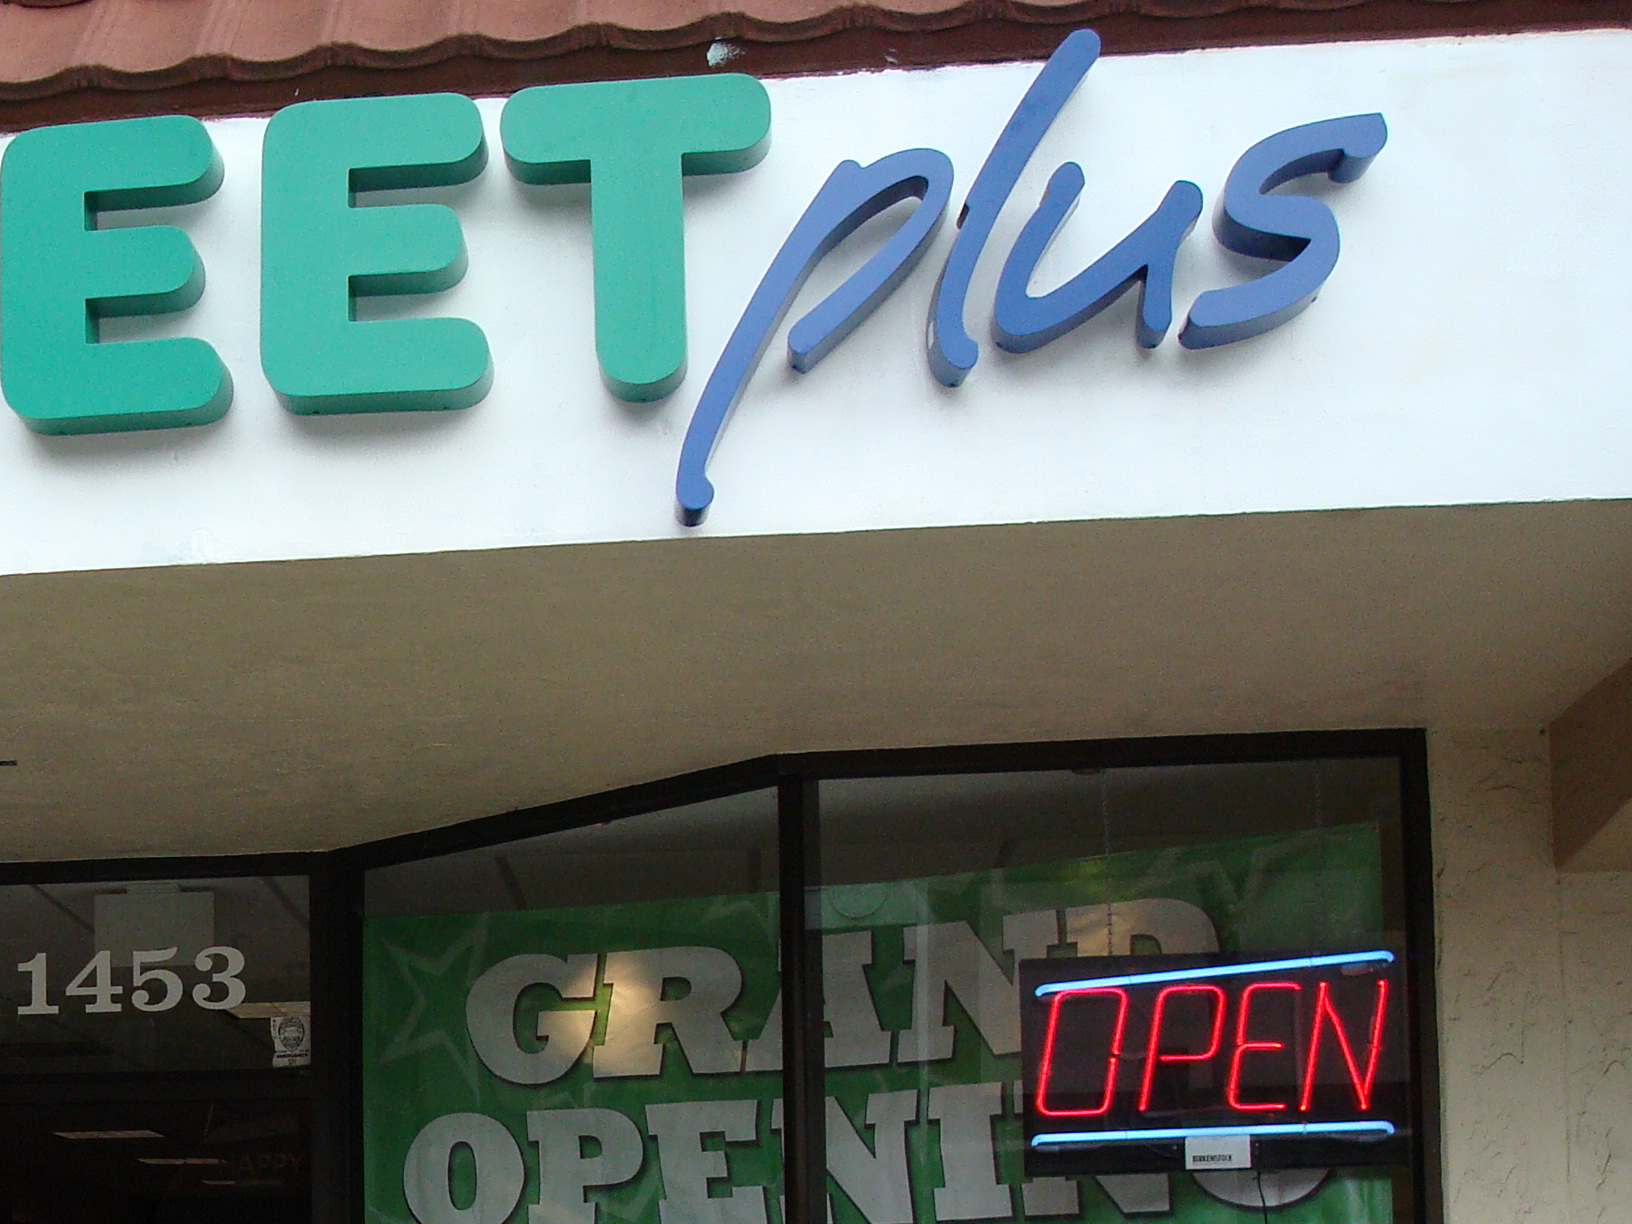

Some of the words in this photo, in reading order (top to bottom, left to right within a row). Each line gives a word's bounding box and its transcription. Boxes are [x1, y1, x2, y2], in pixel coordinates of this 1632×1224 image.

[675, 28, 1389, 527] plus
[16, 945, 248, 1016] 1453
[1036, 979, 1388, 1116] OPEN
